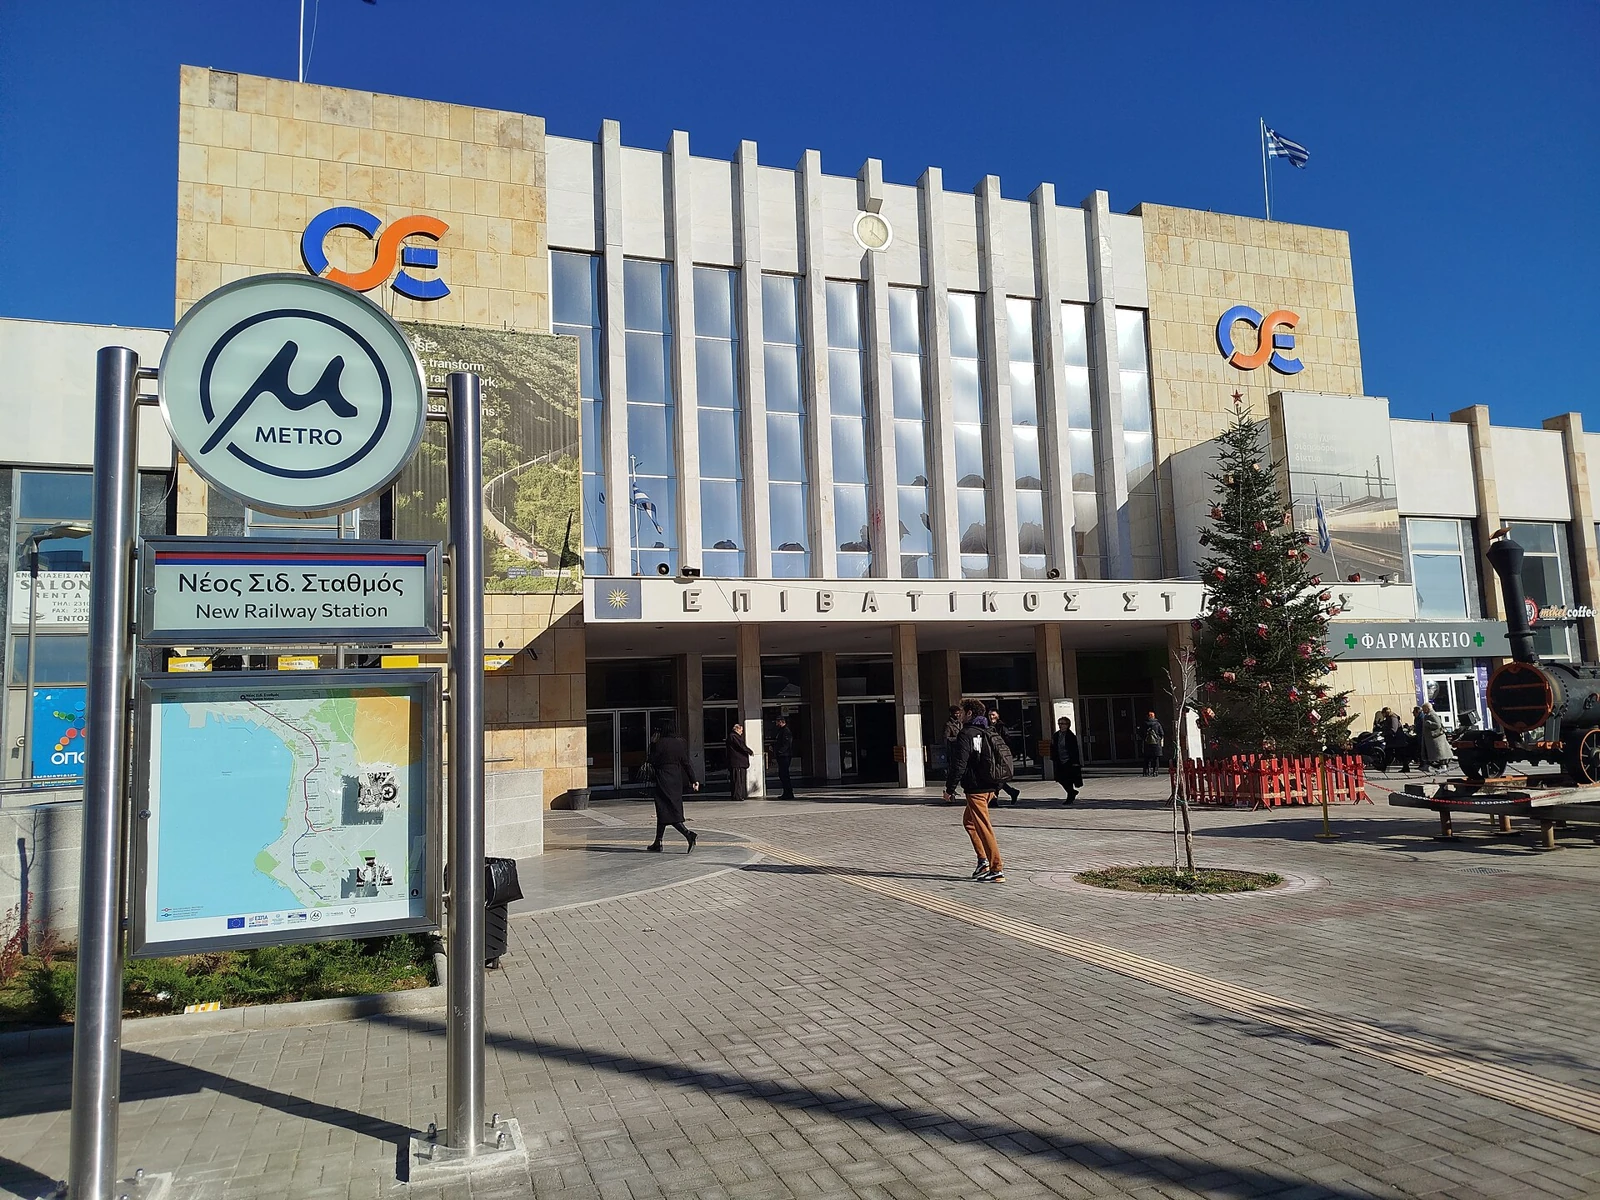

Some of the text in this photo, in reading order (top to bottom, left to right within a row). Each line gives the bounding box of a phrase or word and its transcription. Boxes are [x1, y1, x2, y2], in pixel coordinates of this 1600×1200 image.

[429, 359, 485, 372] transform
[255, 427, 343, 446] METRO
[179, 573, 404, 596] Νέος Σιδ. Σταθμός
[683, 588, 1082, 613] ΕΠΙΒΑΤΙΚΟΣ
[196, 603, 388, 621] New Railway Station
[1540, 605, 1597, 618] mikel coffee
[1361, 631, 1470, 649] ΦΑΡΜΑΚΕΙΟ
